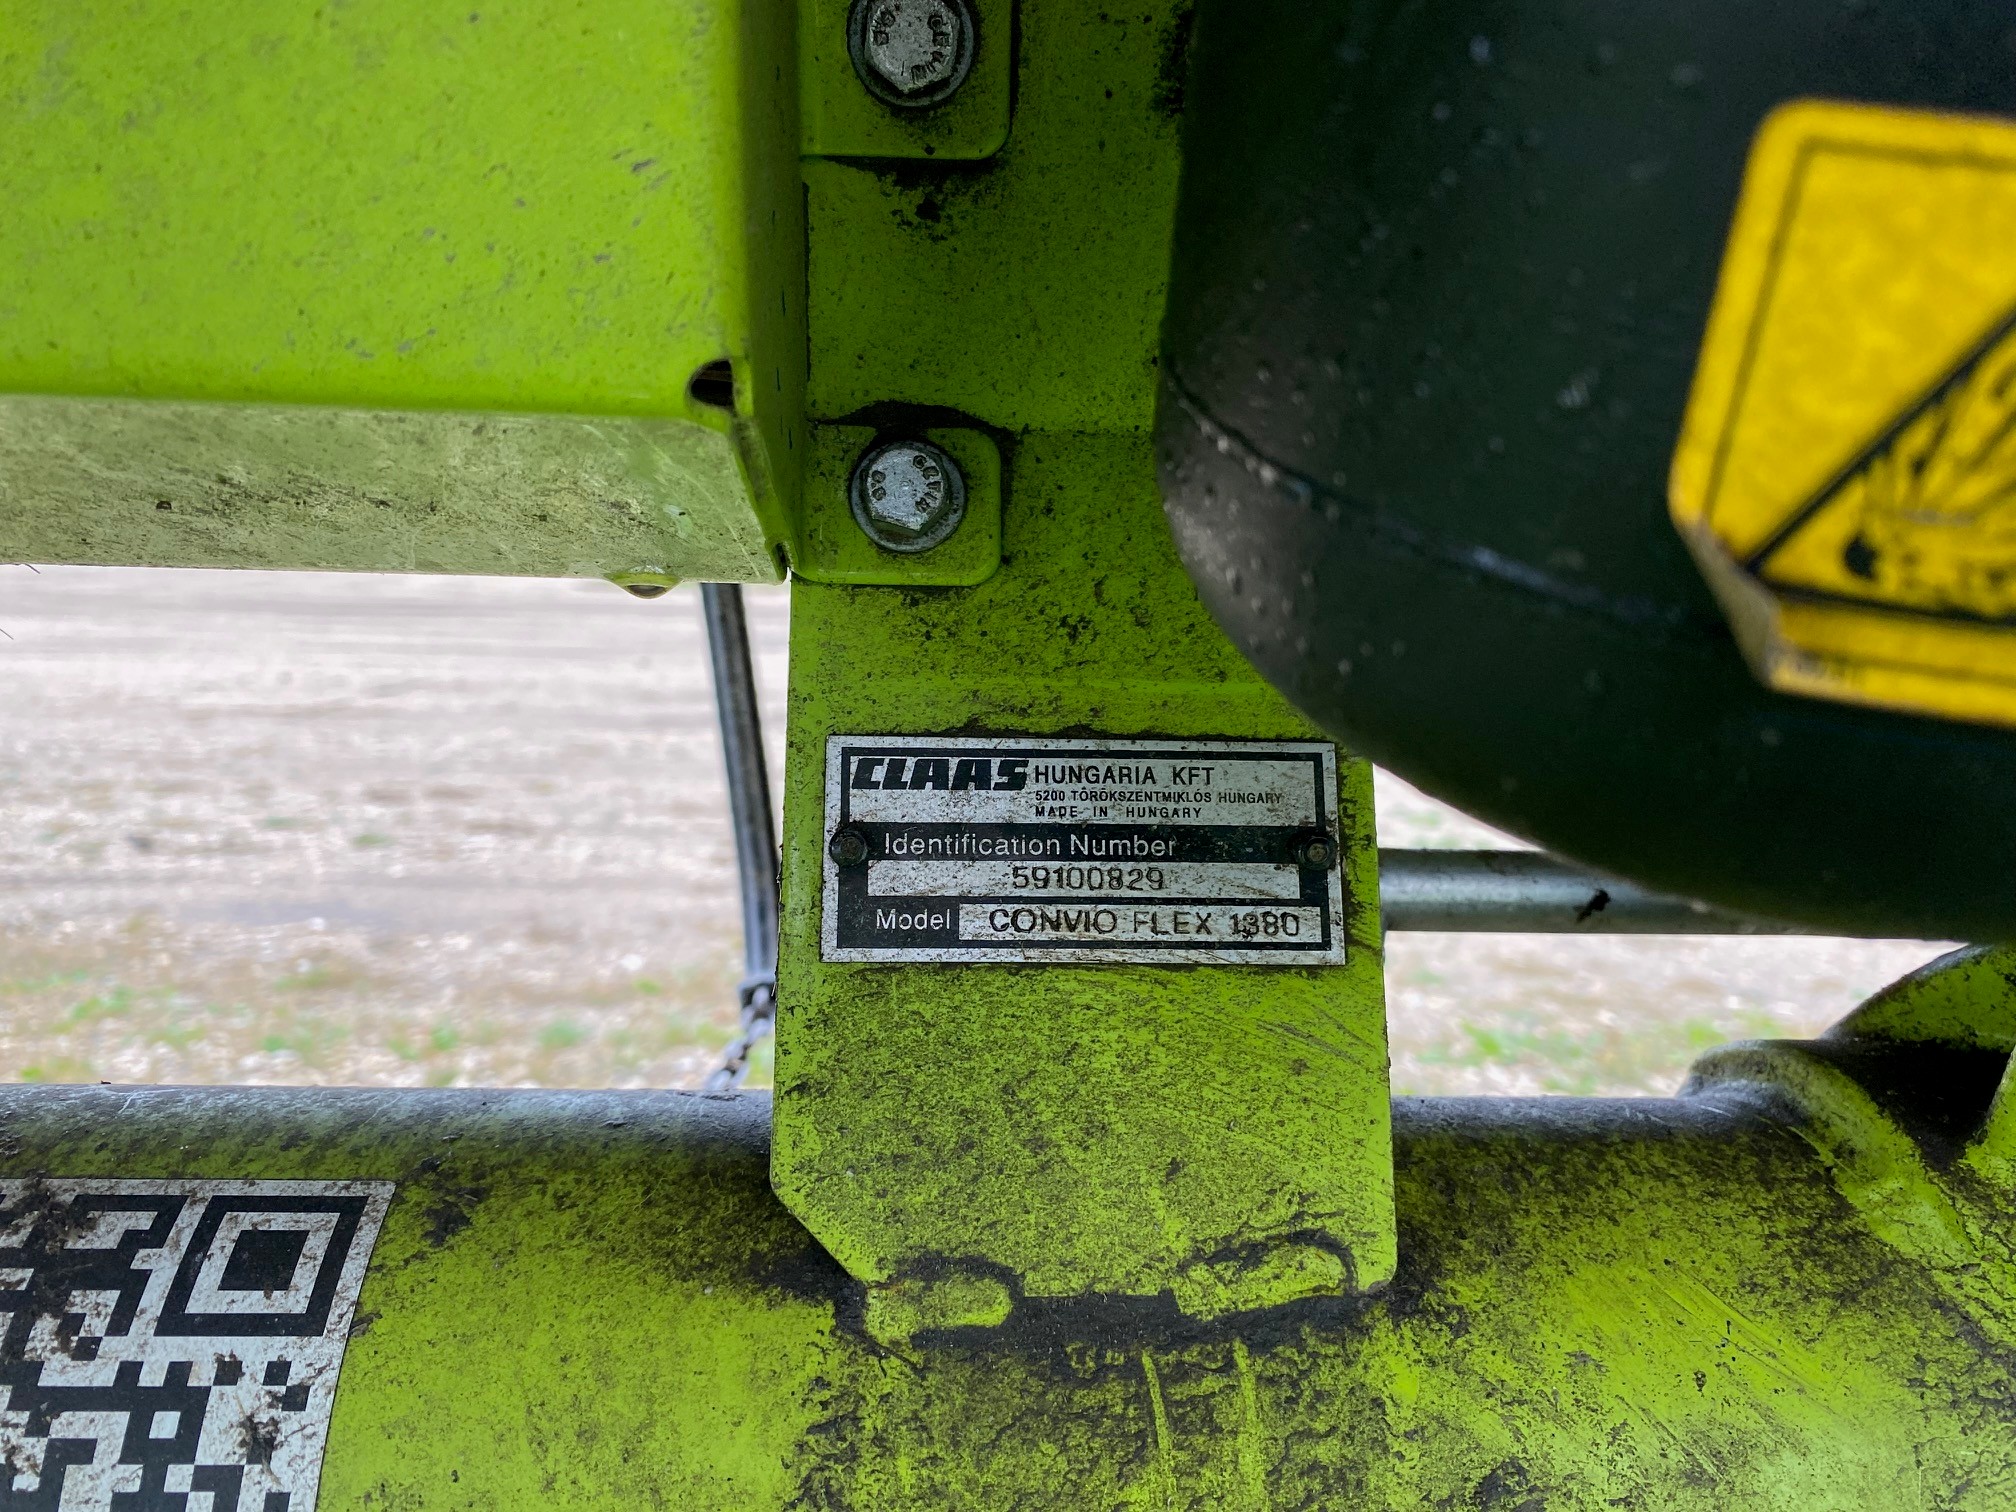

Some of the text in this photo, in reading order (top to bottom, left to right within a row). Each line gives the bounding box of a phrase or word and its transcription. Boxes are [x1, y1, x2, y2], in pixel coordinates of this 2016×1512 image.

[852, 757, 1030, 791] CLAAS
[1034, 764, 1215, 786] HUNGARIA KFT
[1034, 790, 1066, 802] 5200
[1218, 791, 1282, 805] HUNGARY
[1034, 806, 1202, 819] MADE IN HUNGARY
[885, 832, 1176, 856] Identification Number
[1012, 866, 1164, 891] 59100829
[876, 908, 1300, 938] Model CONVIO FLEX 1380
